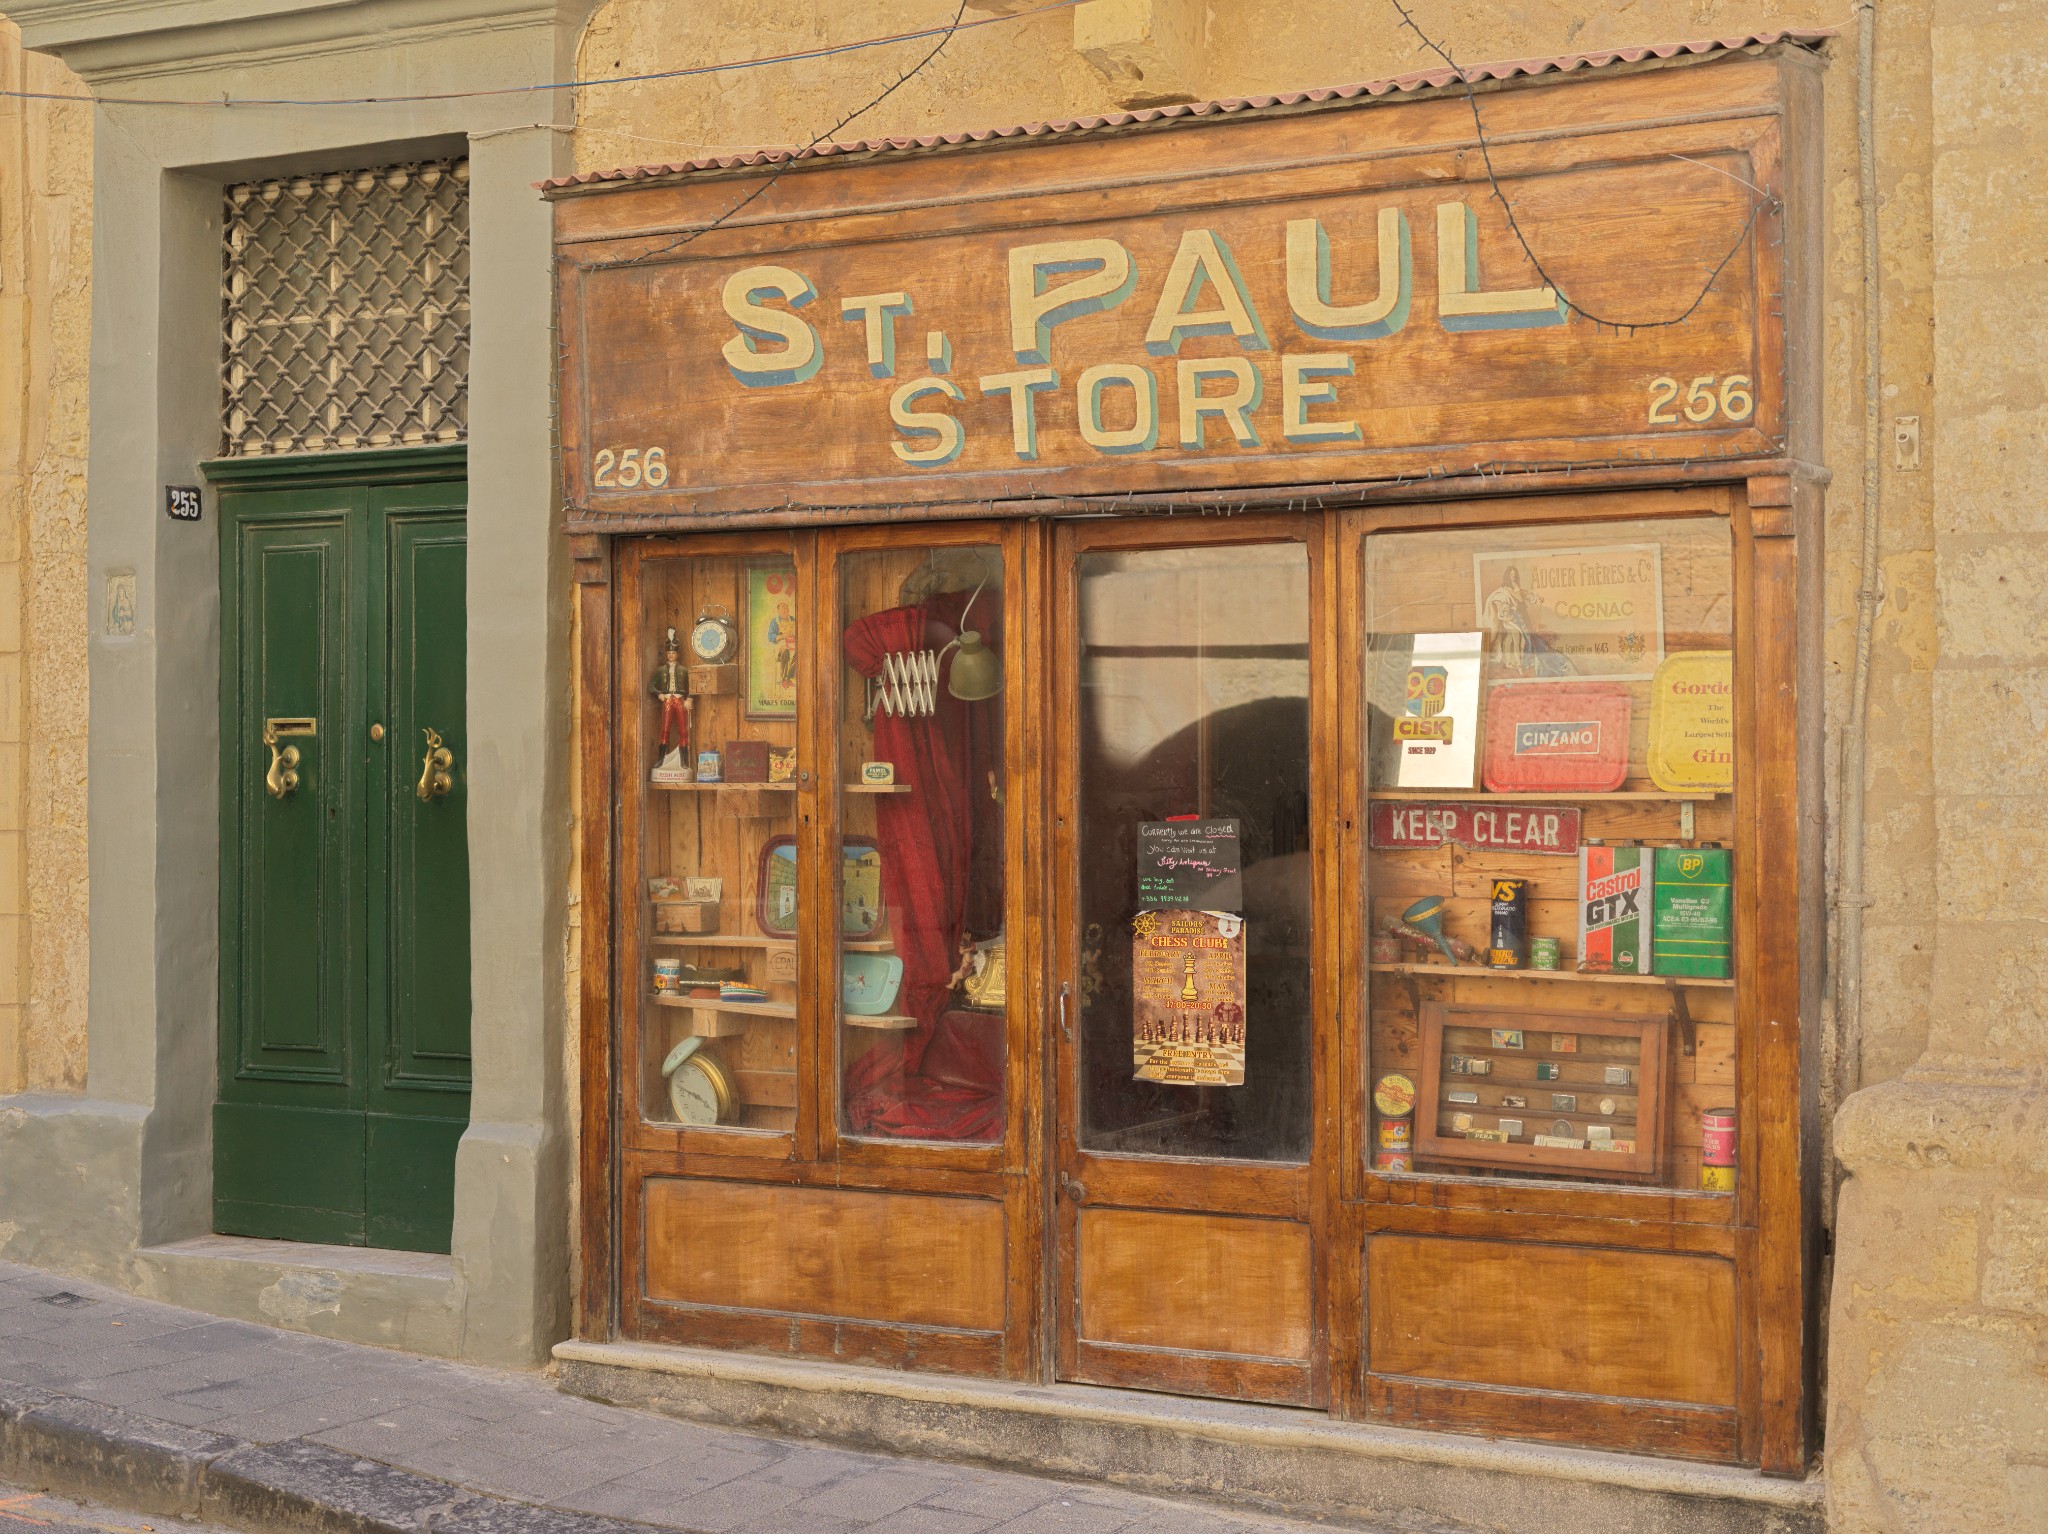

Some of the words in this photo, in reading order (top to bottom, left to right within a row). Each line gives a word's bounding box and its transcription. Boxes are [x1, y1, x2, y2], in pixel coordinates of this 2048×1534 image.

[1009, 202, 1568, 363] PAUL
[1646, 374, 1753, 425] 256
[890, 353, 1363, 467] STORE
[594, 446, 669, 488] 256
[172, 491, 199, 517] 255
[1531, 567, 1576, 589] AUGIER
[1580, 562, 1625, 586] FRÈRES
[1627, 567, 1637, 583] &
[1554, 601, 1633, 619] COGNAC
[1399, 720, 1447, 737] CISK
[1522, 731, 1592, 747] CINZANO
[1693, 749, 1732, 763] Gin
[1142, 825, 1176, 838] Currently
[1393, 809, 1458, 841] KEEP
[1474, 811, 1560, 846] CLEAR
[1683, 858, 1700, 870] BP
[1586, 868, 1640, 902] Castrol
[1587, 887, 1641, 926] GTX
[1152, 936, 1188, 947] CHESS
[1208, 952, 1233, 960] APRIL
[1166, 1001, 1212, 1010] 17:00-20:30
[1185, 1050, 1214, 1058] ENTRY
